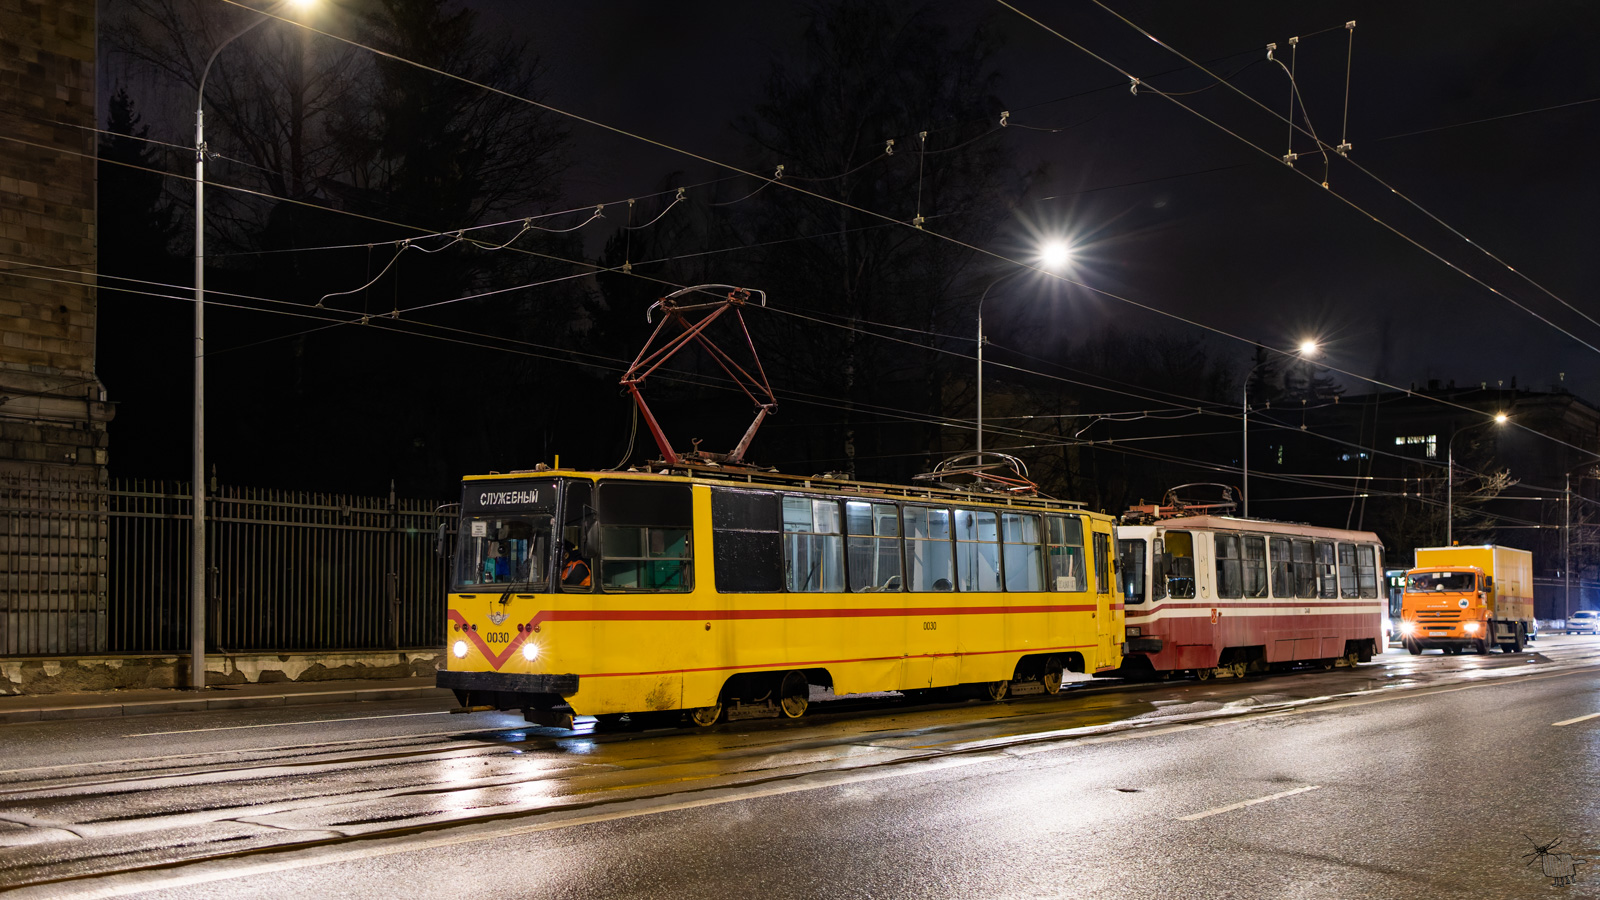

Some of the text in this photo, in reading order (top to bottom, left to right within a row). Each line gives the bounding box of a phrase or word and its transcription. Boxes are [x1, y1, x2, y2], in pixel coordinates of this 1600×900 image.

[480, 488, 539, 506] СЛУЖЕБНЫЙ
[923, 621, 937, 631] 0030
[486, 632, 510, 643] 0030
